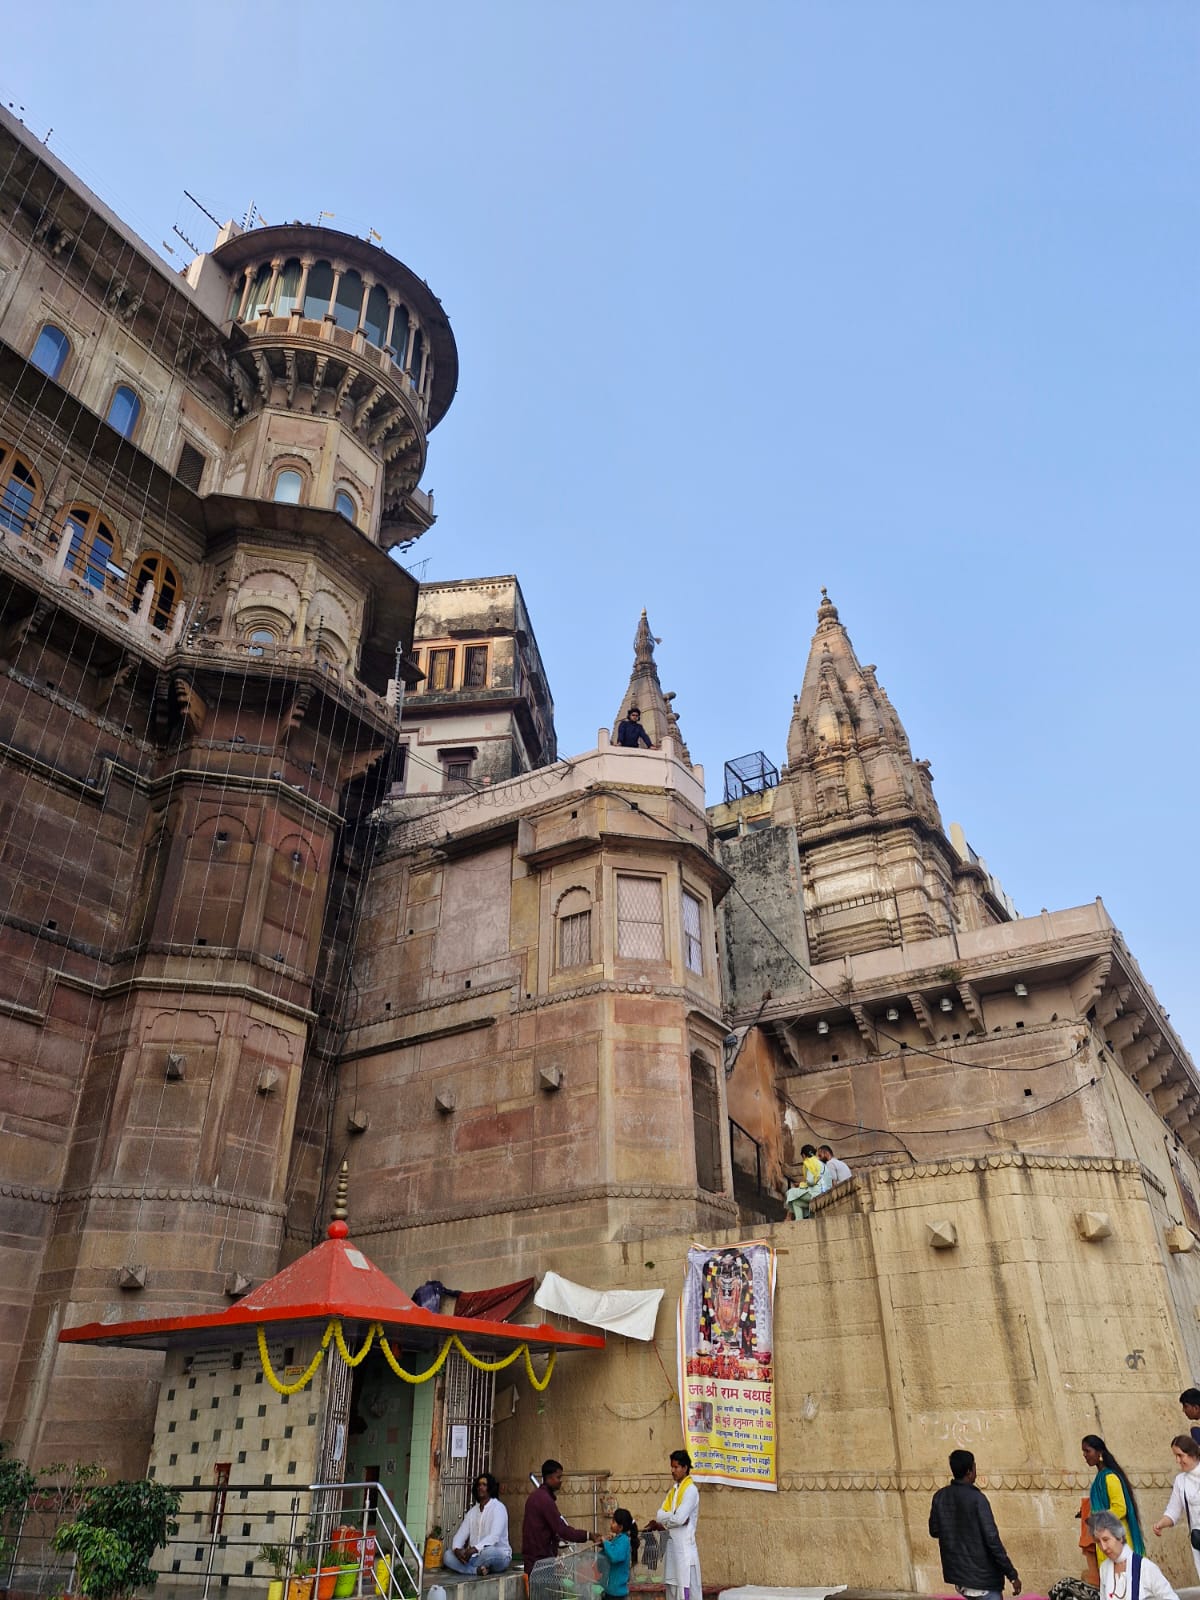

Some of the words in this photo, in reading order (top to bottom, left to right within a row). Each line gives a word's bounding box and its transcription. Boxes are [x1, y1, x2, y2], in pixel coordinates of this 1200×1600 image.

[706, 1382, 717, 1397] श्री
[721, 1387, 738, 1399] राम
[743, 1386, 772, 1405] बधाई
[733, 1418, 753, 1429] हनुमान
[756, 1417, 763, 1428] जी
